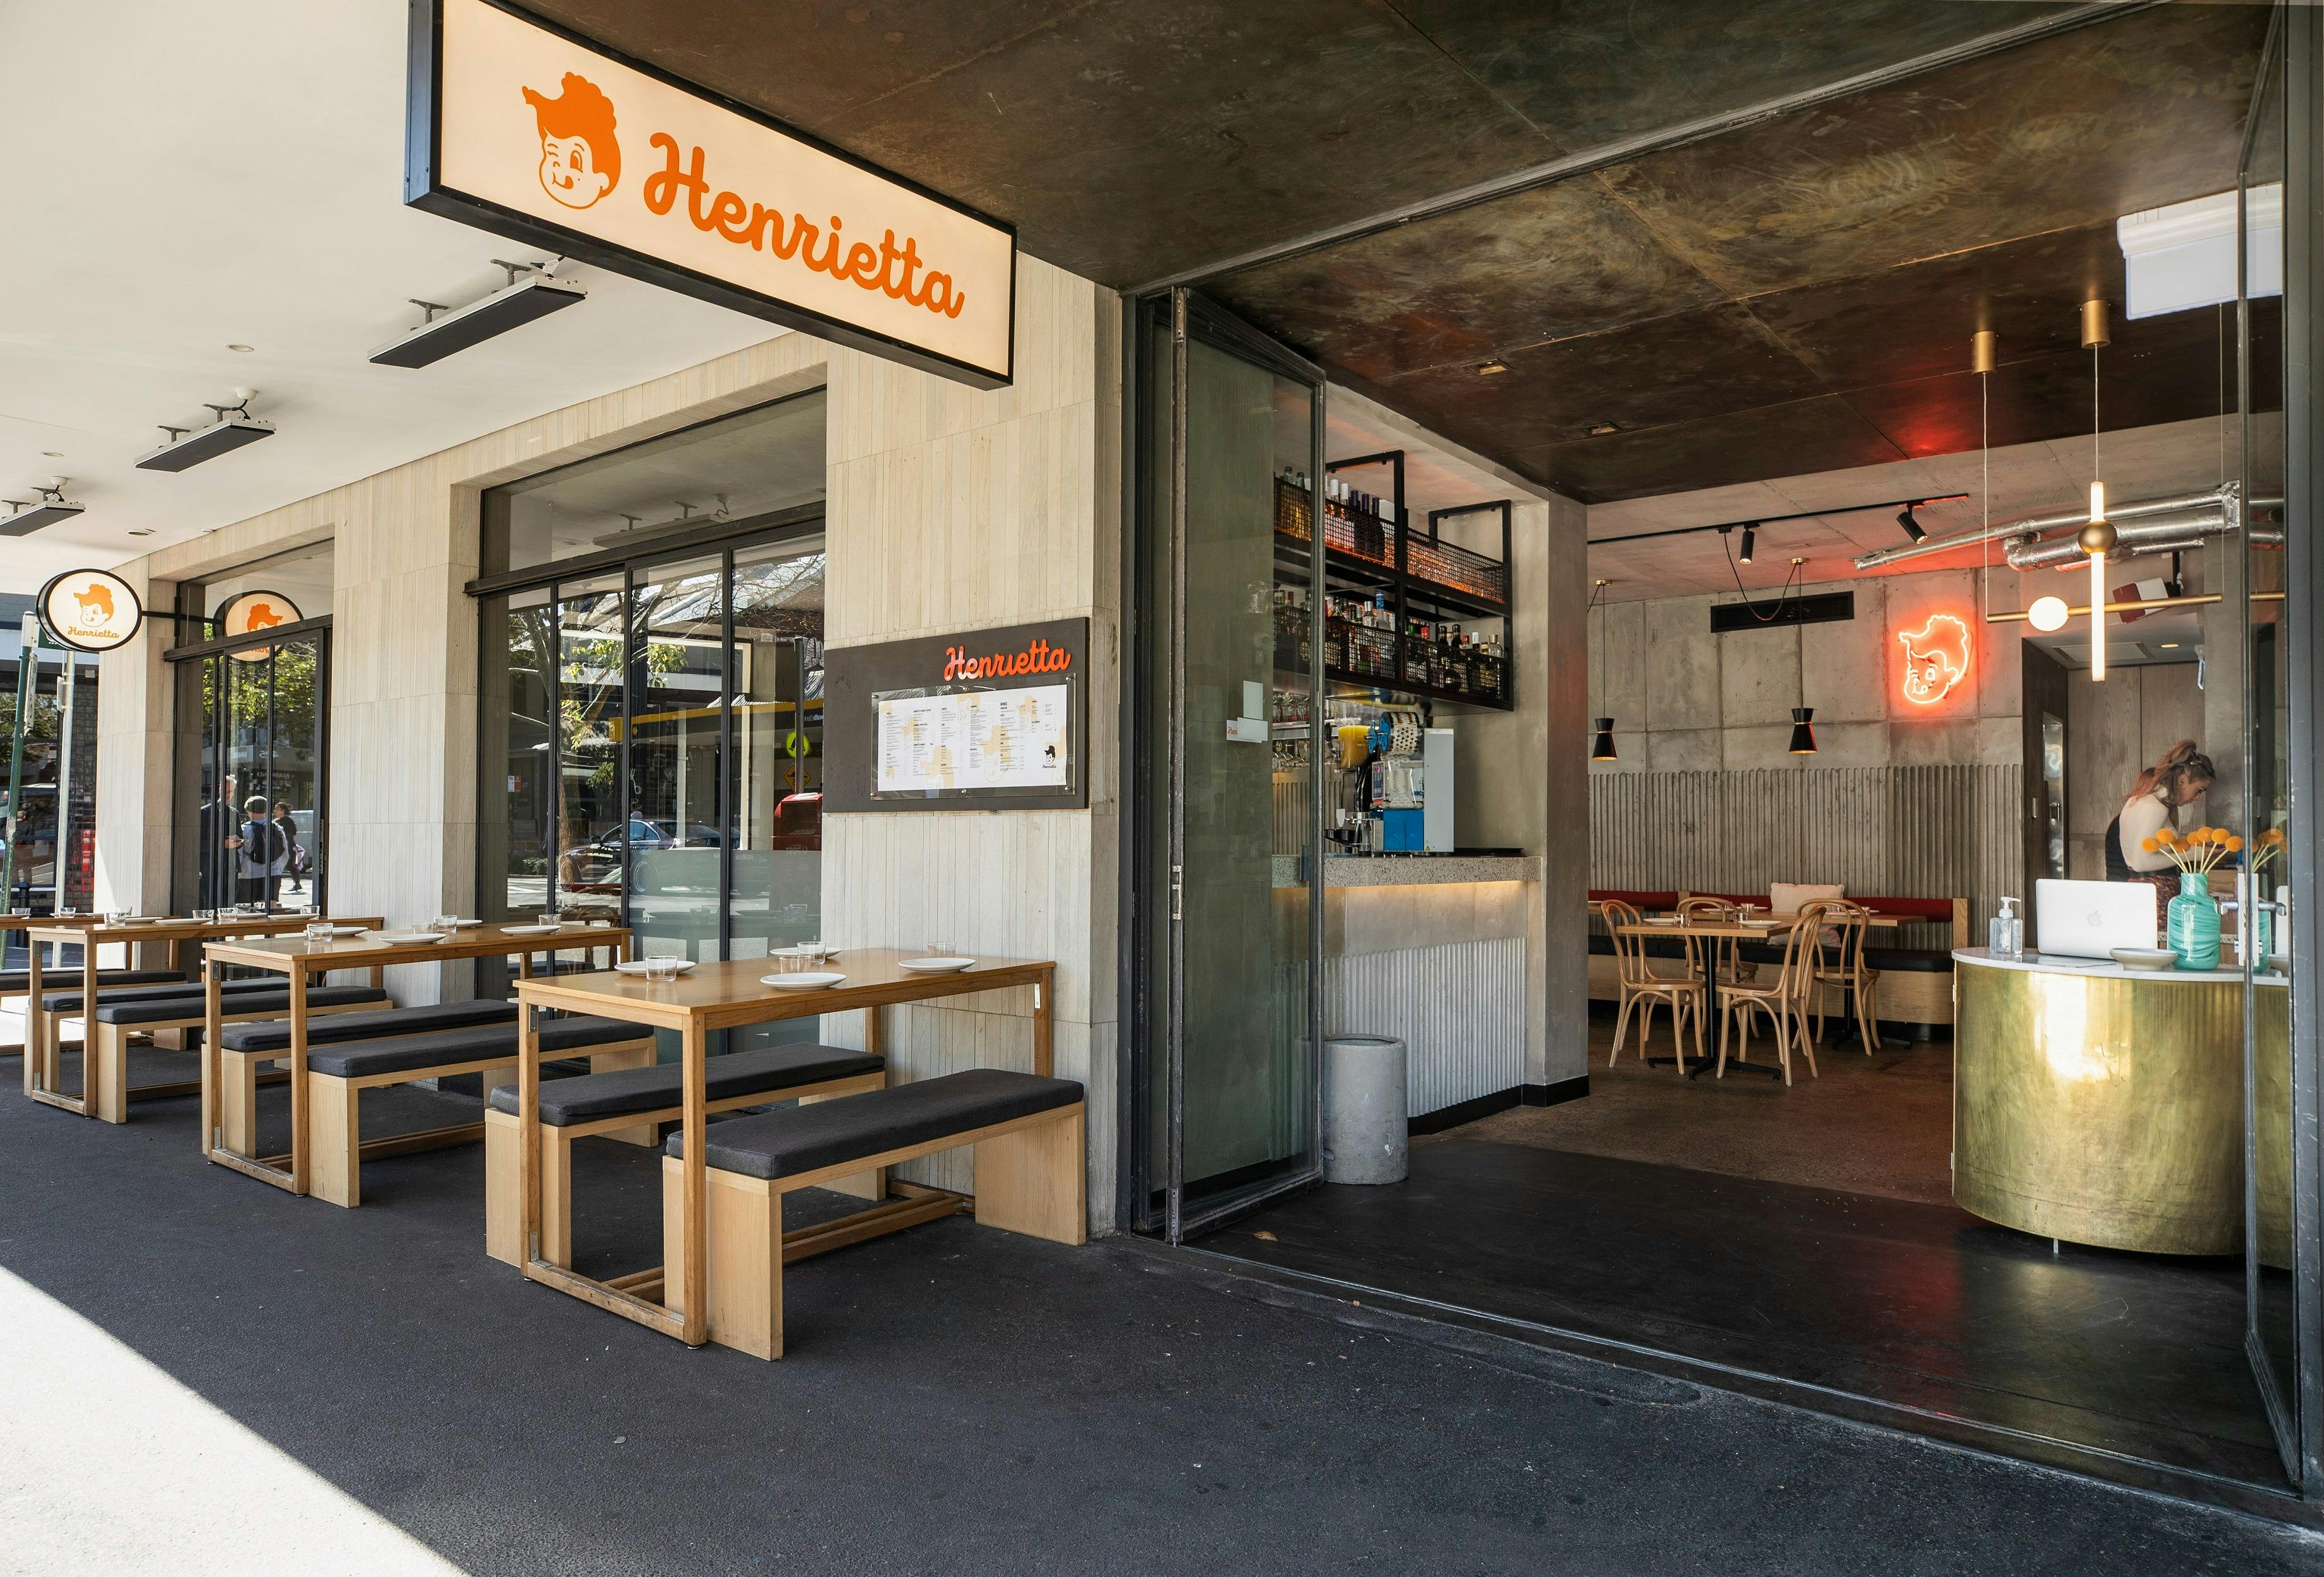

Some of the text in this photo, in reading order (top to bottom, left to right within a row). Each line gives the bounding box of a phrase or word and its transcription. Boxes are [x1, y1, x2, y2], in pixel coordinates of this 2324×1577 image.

[644, 132, 964, 319] Henrietta
[67, 626, 120, 638] Henrietta
[943, 638, 1071, 681] Henrietta
